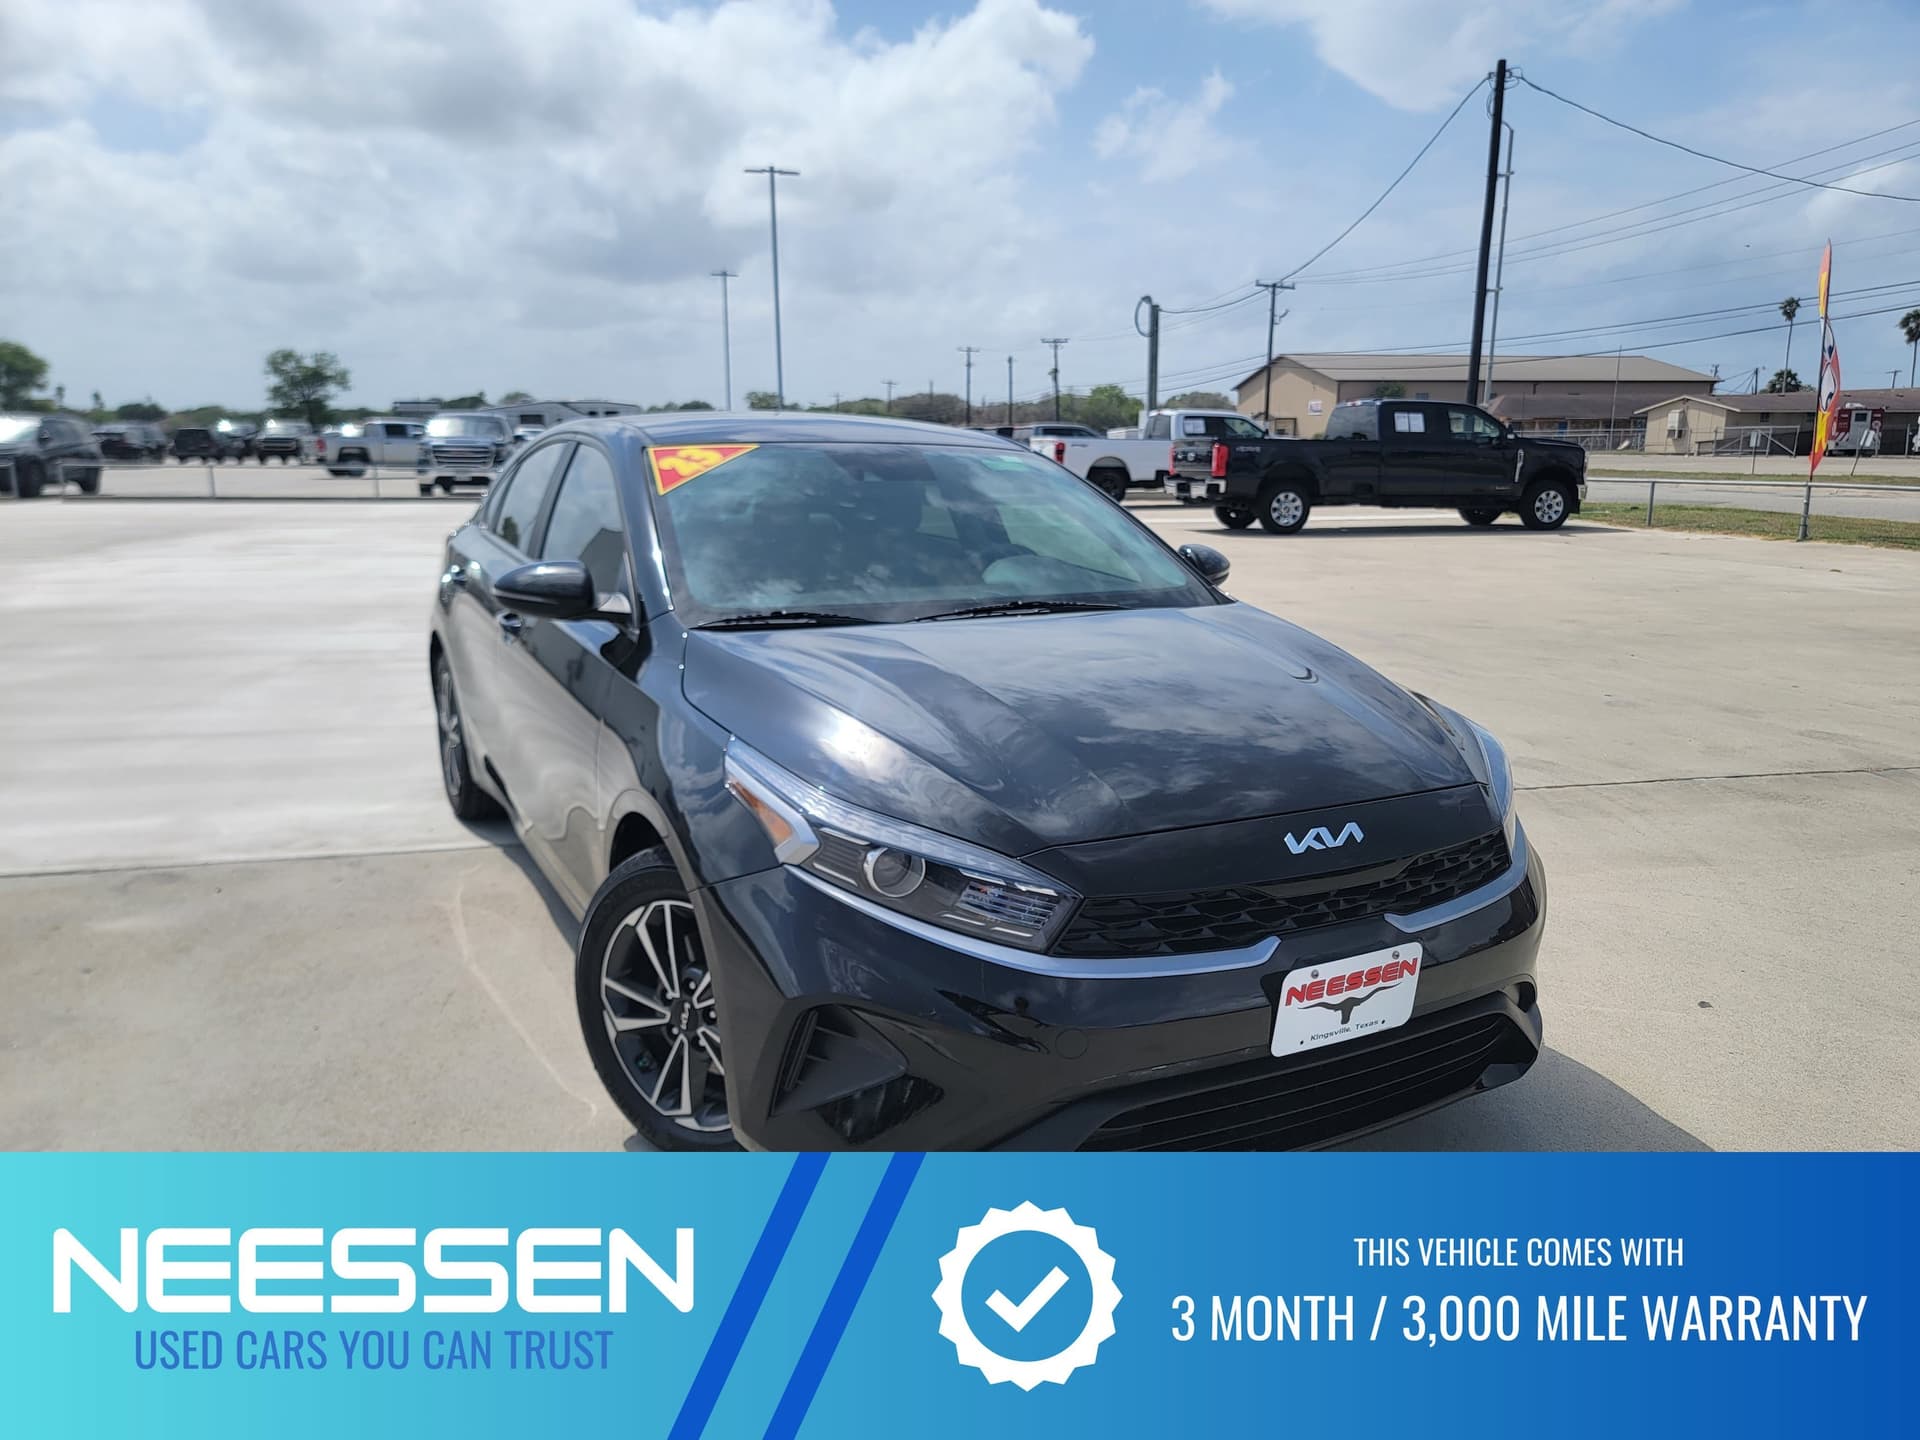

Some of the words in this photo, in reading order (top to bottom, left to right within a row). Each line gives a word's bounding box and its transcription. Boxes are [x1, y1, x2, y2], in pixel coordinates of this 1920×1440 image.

[1283, 822, 1365, 855] KIA
[1284, 957, 1419, 1006] NEESSEN
[1355, 1020, 1379, 1031] Texas
